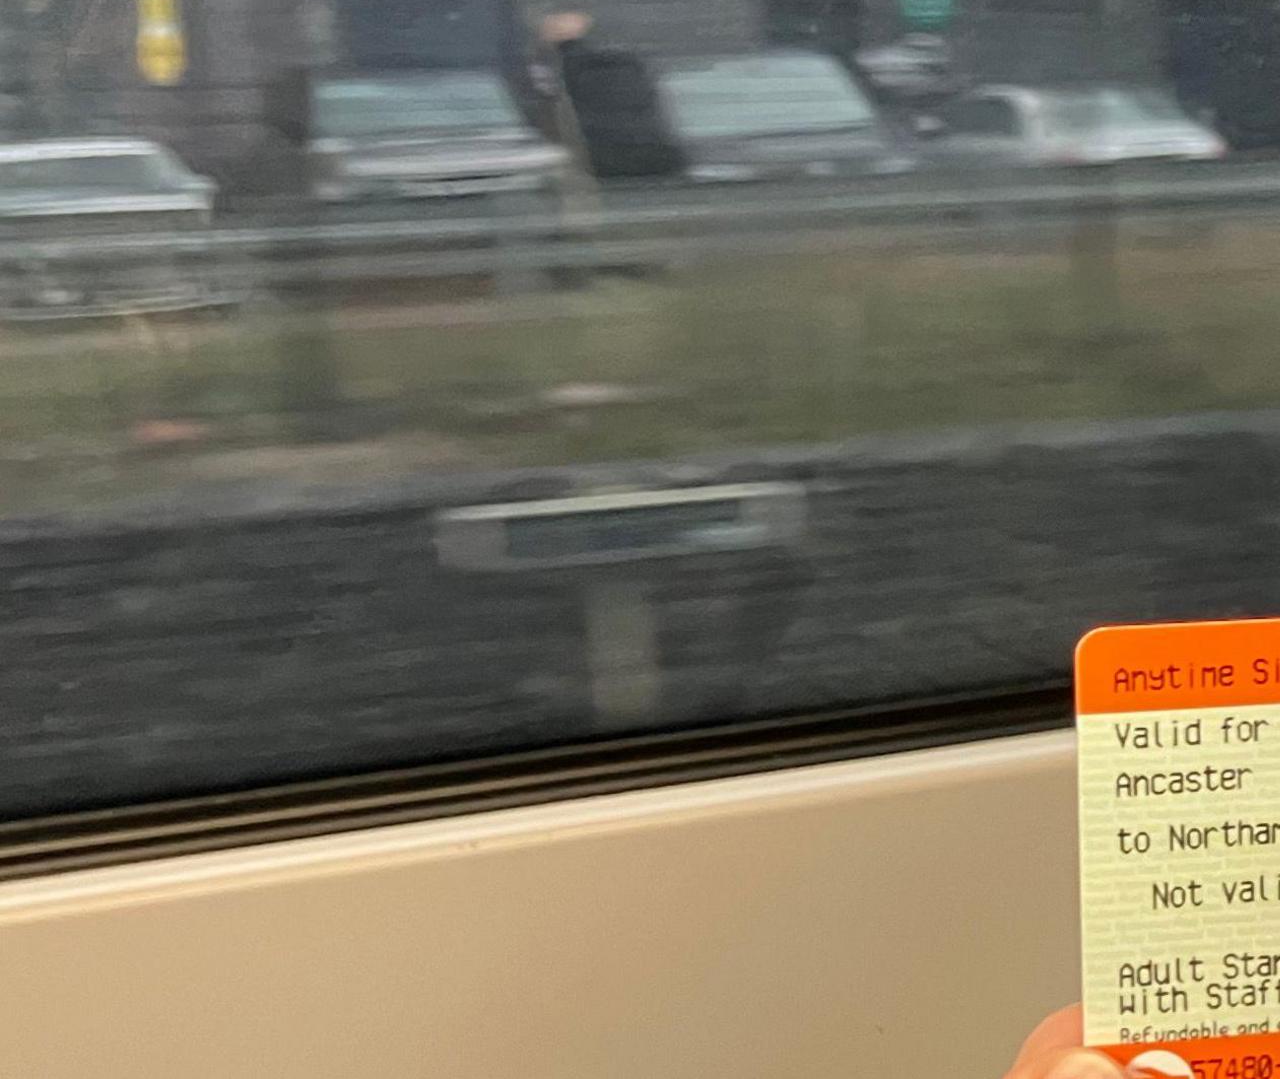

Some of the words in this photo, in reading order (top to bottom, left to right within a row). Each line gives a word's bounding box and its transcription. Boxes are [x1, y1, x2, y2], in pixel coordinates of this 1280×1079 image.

[1114, 662, 1234, 693] Anytime
[1115, 719, 1202, 749] Valid
[1220, 717, 1269, 744] for
[1116, 766, 1253, 798] Ancaster
[1117, 828, 1150, 854] to
[1152, 880, 1203, 910] Not
[1119, 956, 1204, 988] Adult
[1119, 1021, 1228, 1044] Refundable
[1237, 1016, 1270, 1035] and
